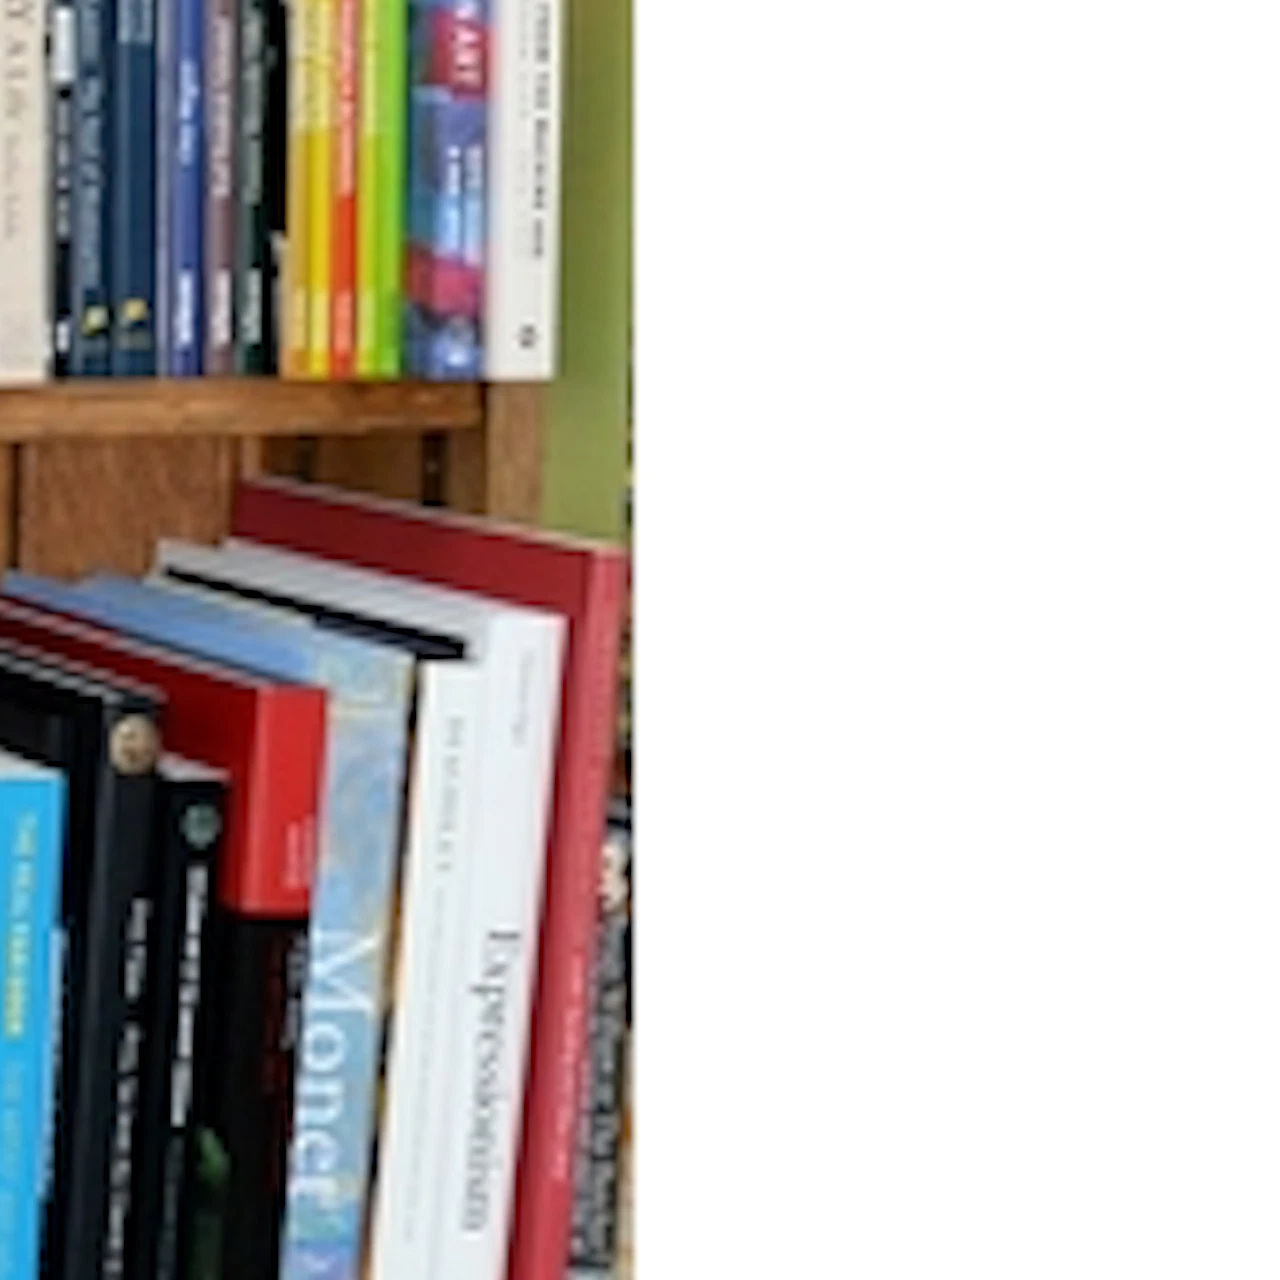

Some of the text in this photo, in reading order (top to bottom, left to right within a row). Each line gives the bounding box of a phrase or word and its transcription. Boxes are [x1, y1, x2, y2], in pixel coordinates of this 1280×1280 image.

[2, 67, 32, 120] Life
[452, 24, 482, 89] ART
[293, 923, 376, 1209] Monet
[458, 925, 521, 1235] Expressionism
